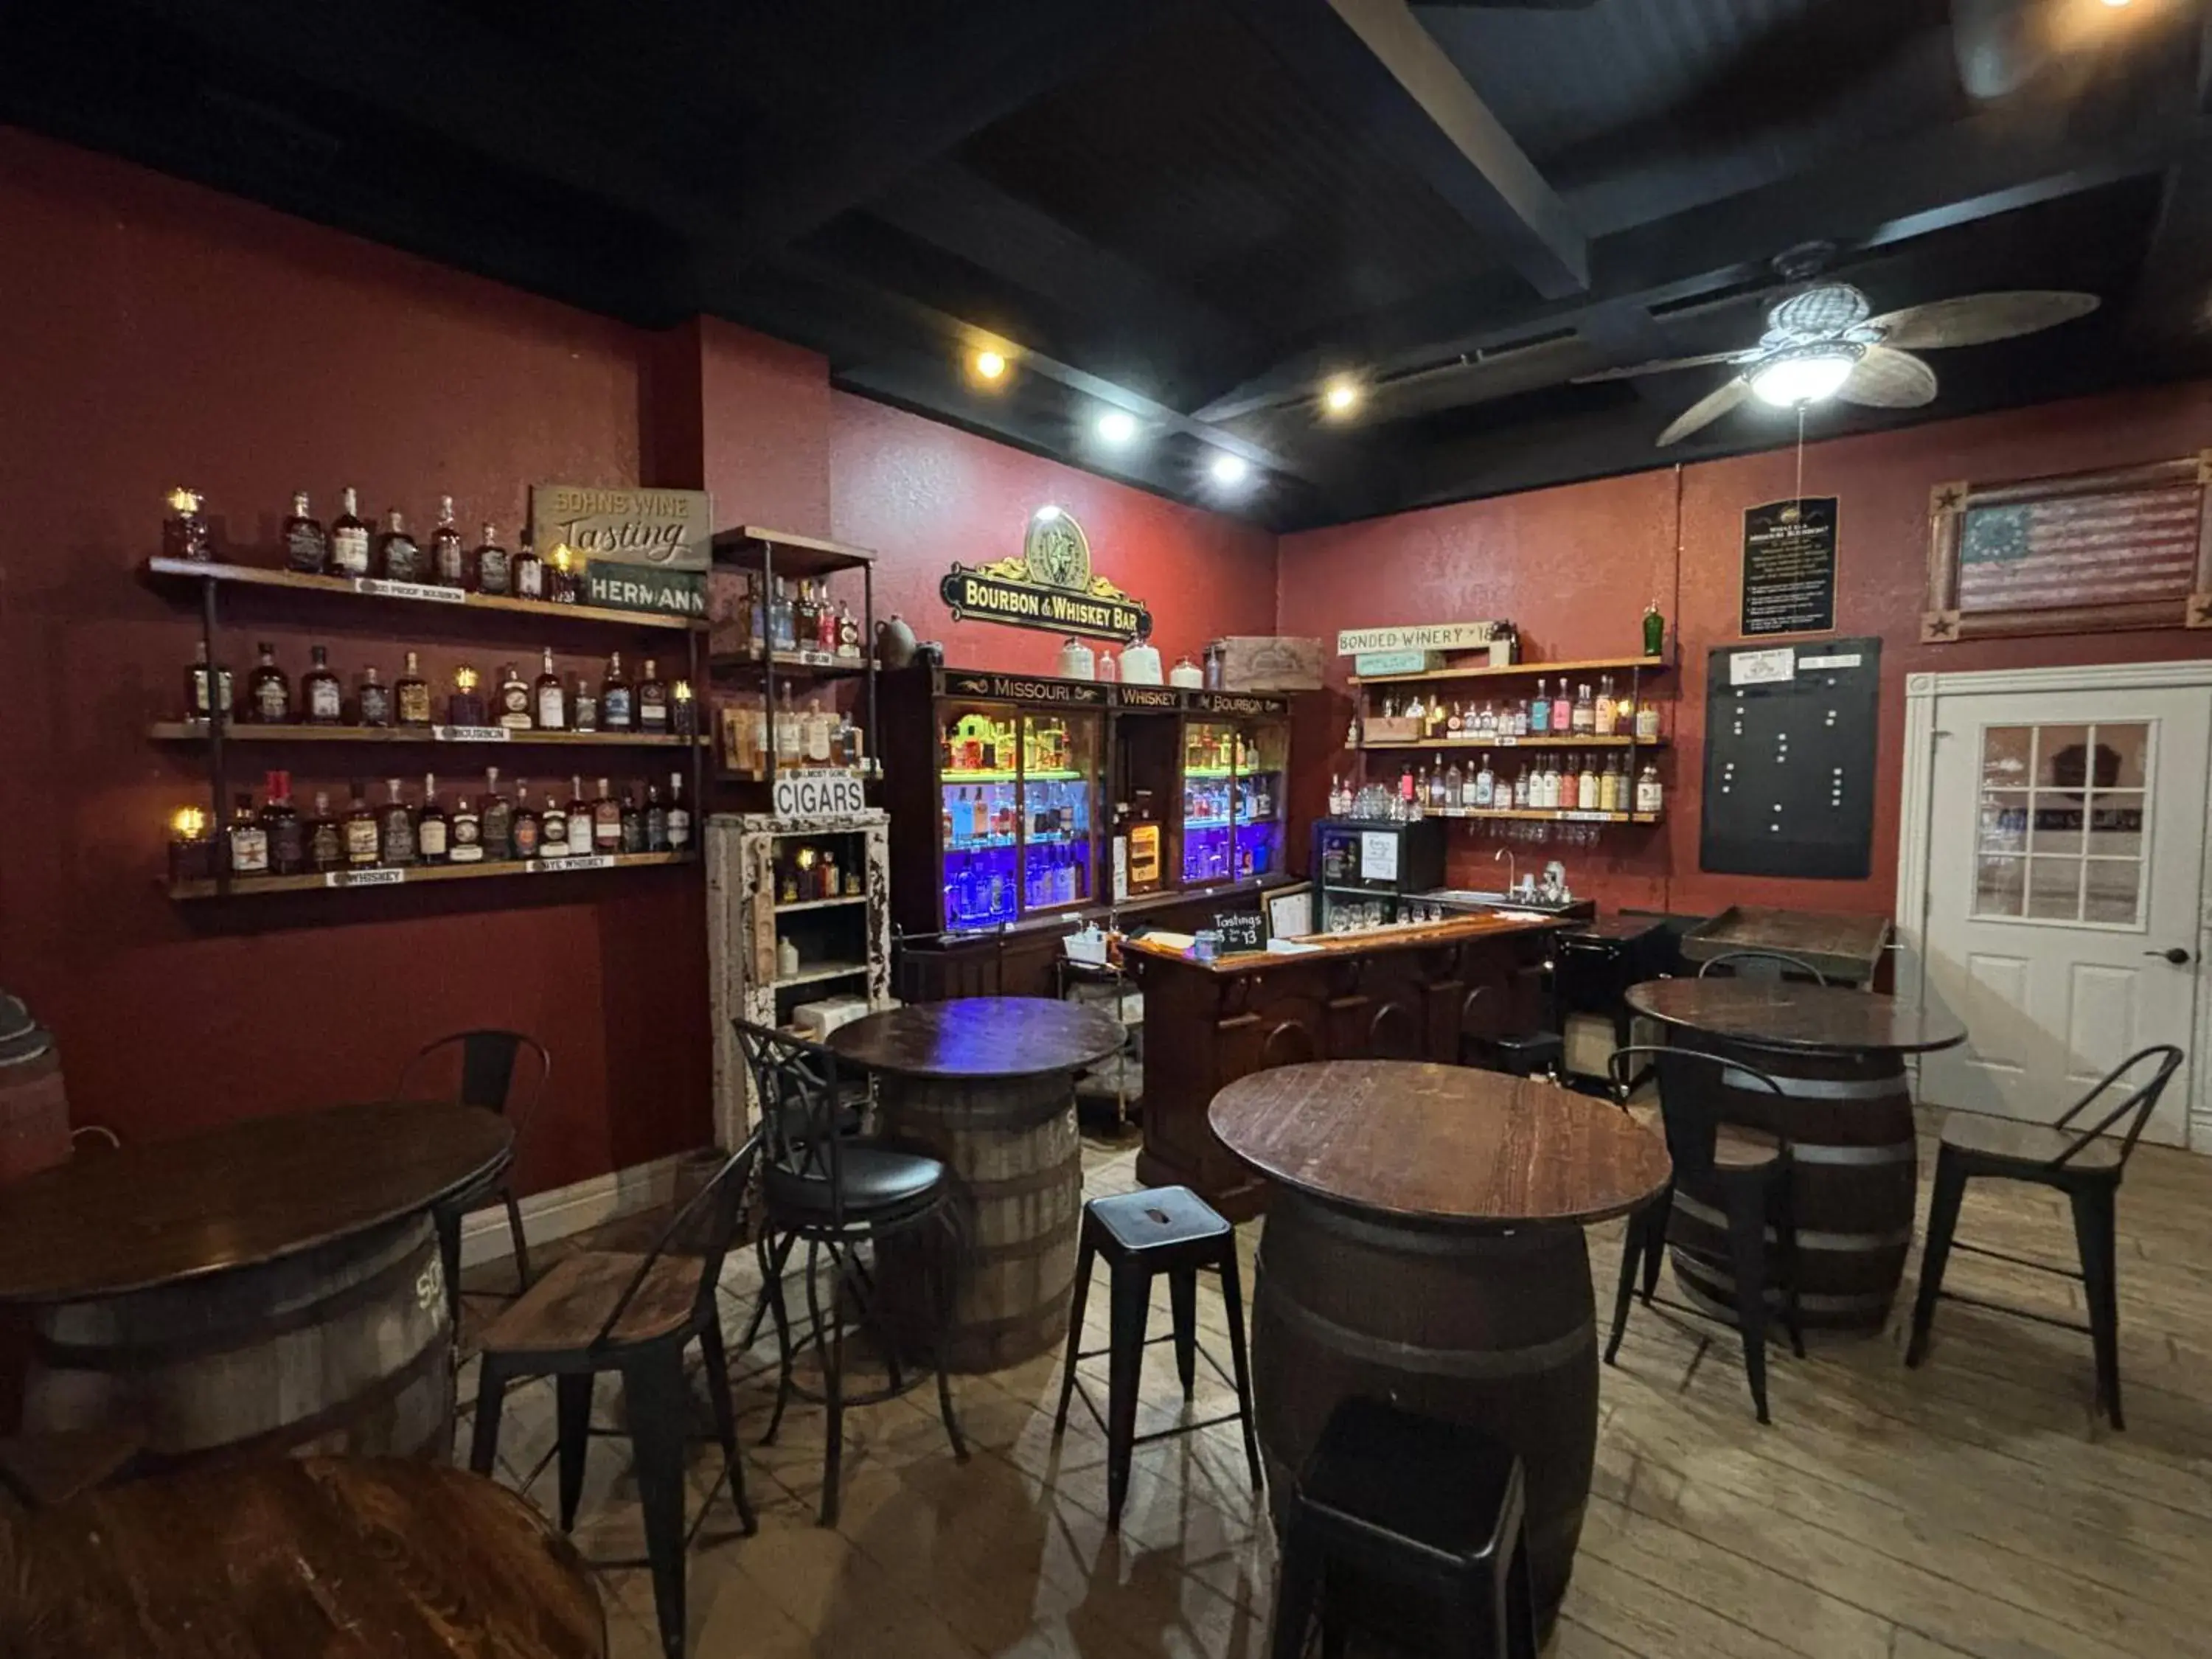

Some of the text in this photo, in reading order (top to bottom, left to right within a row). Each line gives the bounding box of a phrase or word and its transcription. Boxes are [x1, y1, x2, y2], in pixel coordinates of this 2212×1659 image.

[634, 495, 690, 519] WINE
[554, 516, 692, 563] Tasting
[591, 577, 705, 612] HERMANN
[965, 579, 1038, 616] BOURBON
[1052, 595, 1110, 627] WHISKEY
[1113, 608, 1138, 632] BAR
[1339, 632, 1397, 650] BONDED
[1403, 627, 1464, 644] WINERY
[994, 678, 1070, 700] MISSOURI
[1121, 687, 1177, 706] WHISKEY
[1213, 695, 1263, 714] BOURBON
[778, 782, 862, 815] CIGARS
[347, 871, 401, 883] WHISKEY
[1214, 913, 1262, 930] Tastings
